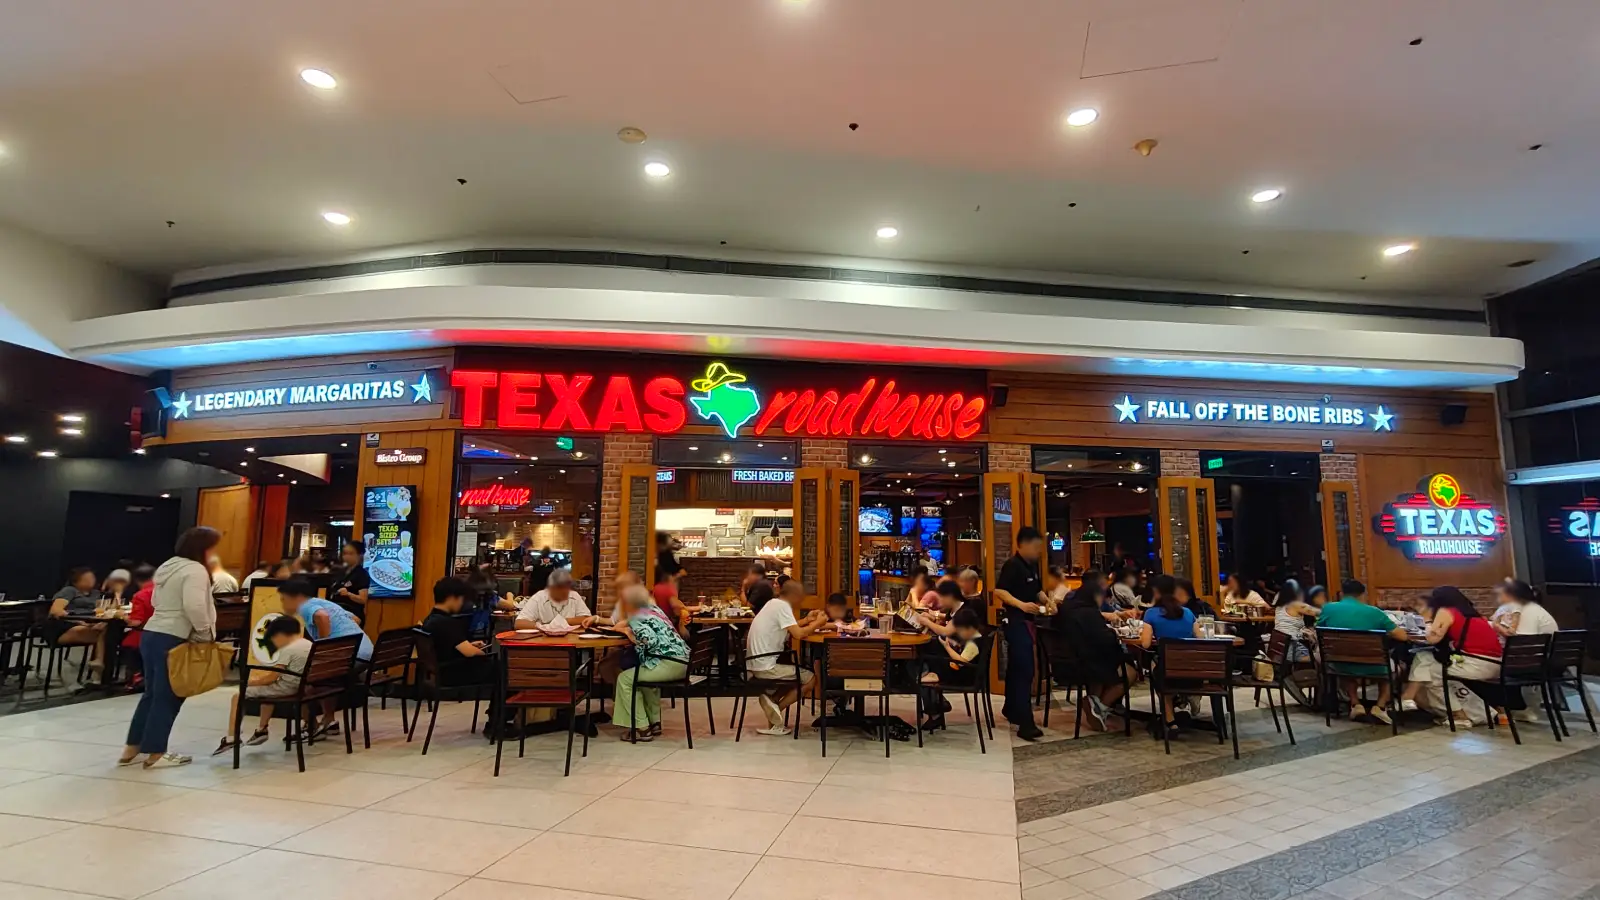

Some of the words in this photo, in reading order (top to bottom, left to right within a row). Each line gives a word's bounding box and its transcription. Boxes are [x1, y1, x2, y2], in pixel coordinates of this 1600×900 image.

[194, 387, 286, 412] LEGENDARY
[289, 380, 405, 404] MARGARITAS
[451, 370, 686, 433] TEXAS
[1147, 400, 1190, 419] FALL
[1195, 402, 1229, 420] OFF
[1233, 403, 1268, 421] THE
[1273, 405, 1320, 423] BONE
[1324, 407, 1364, 424] RIBS
[376, 454, 399, 463] Bistro
[399, 453, 423, 464] Group
[733, 470, 758, 481] FRESH
[758, 471, 784, 482] BAKED
[366, 491, 387, 503] 2+1
[378, 525, 399, 533] TEXAS
[1399, 508, 1496, 536] TEXAS
[1419, 539, 1483, 555] ROADHOUSE
